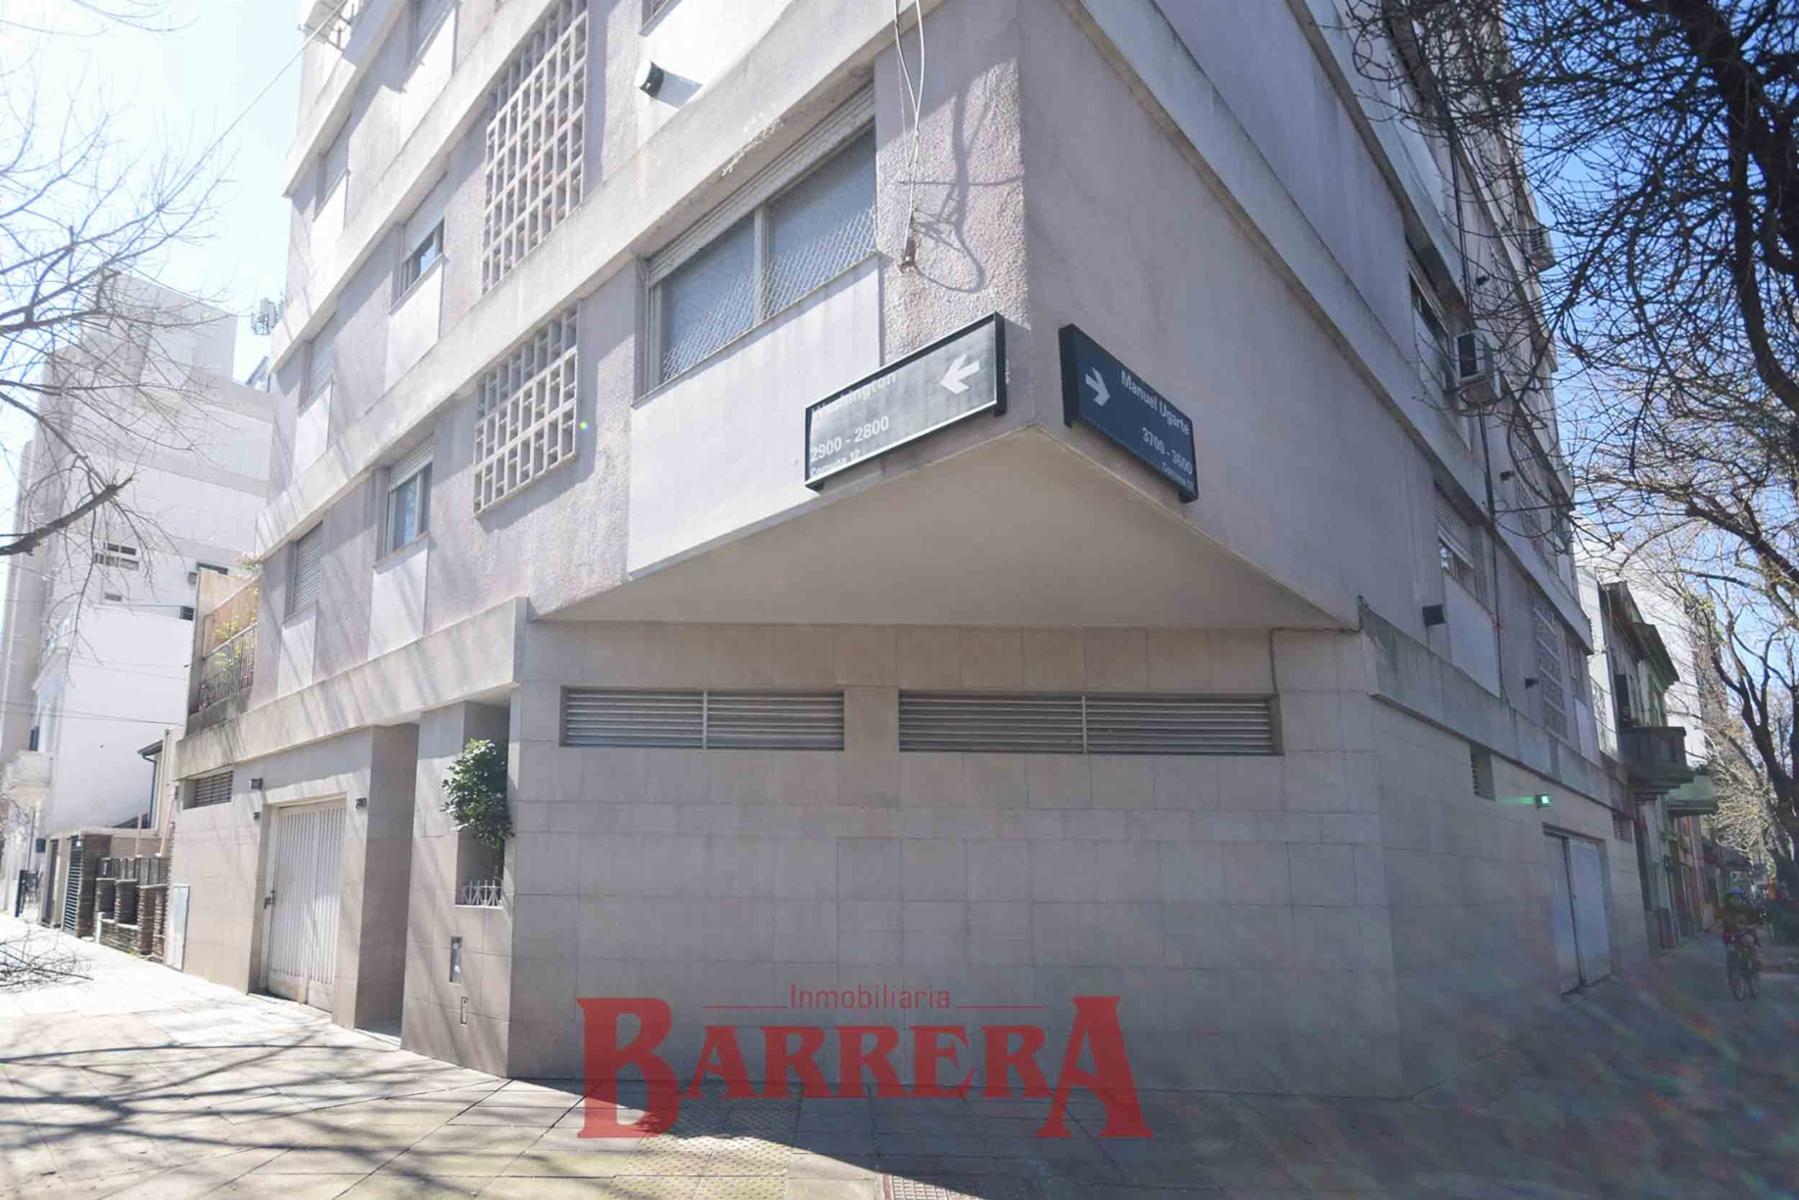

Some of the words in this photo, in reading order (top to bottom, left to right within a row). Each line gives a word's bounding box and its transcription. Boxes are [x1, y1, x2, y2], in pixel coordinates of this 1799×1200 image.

[812, 371, 897, 417] Wshington
[1121, 370, 1158, 411] Manuel
[1159, 400, 1190, 435] Ugarte
[810, 436, 842, 463] 2900
[854, 416, 889, 442] 2800
[1142, 427, 1165, 455] 3700
[1171, 449, 1193, 475] 3600
